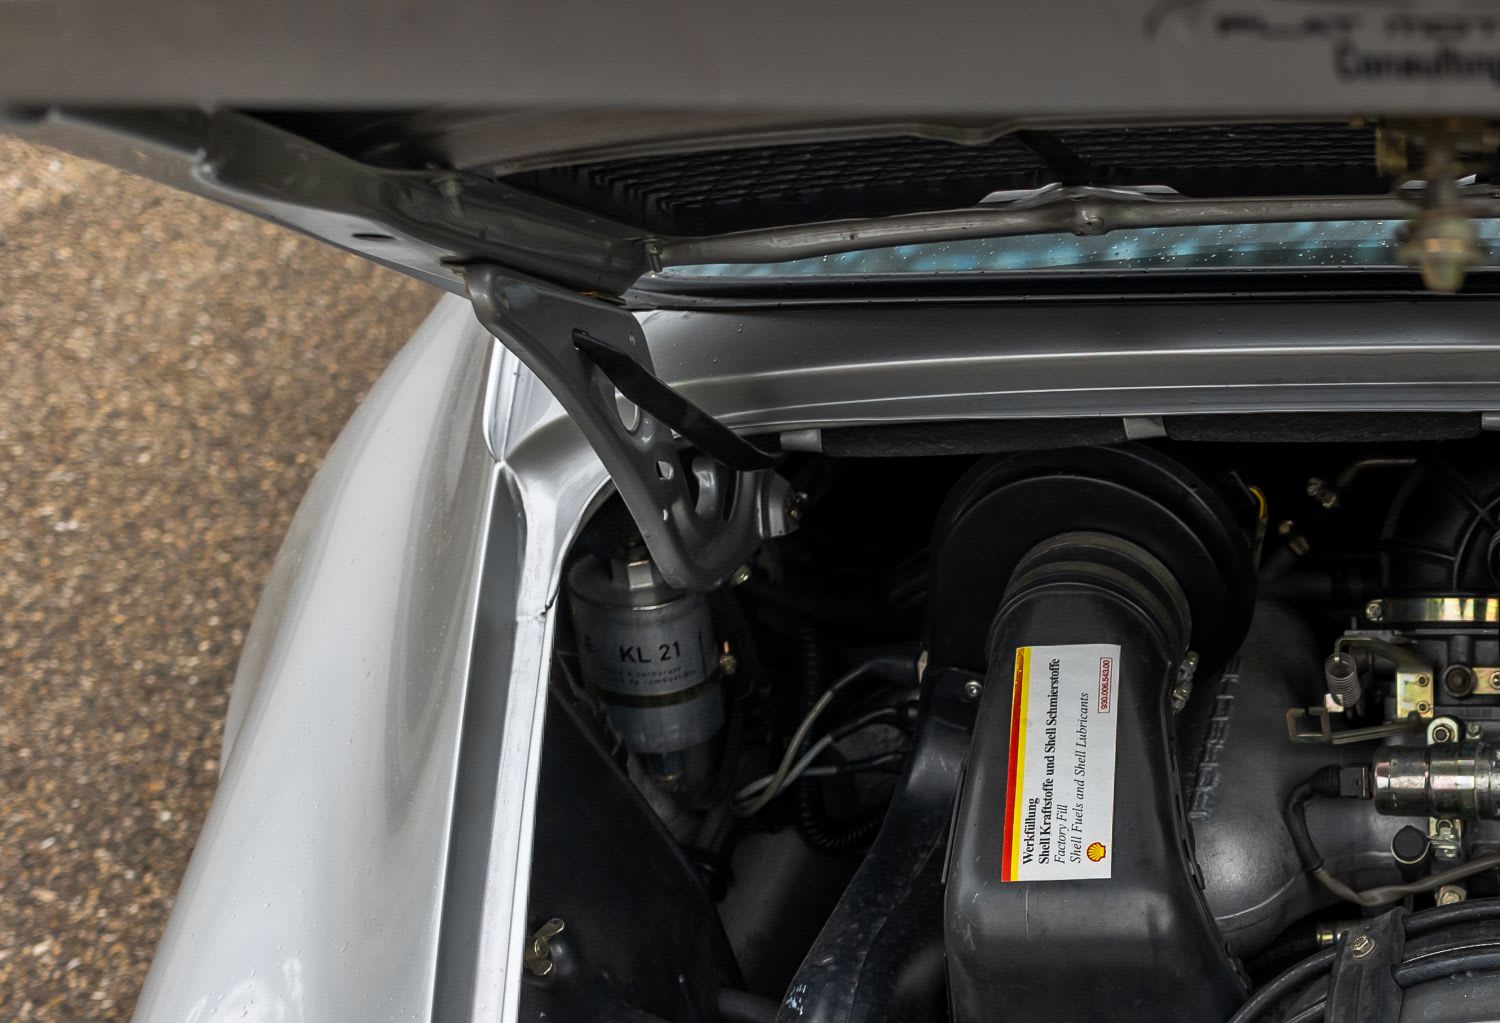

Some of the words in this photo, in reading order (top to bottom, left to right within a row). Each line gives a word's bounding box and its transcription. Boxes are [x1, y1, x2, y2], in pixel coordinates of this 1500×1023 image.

[619, 646, 652, 664] KL
[658, 641, 680, 661] 21
[1046, 658, 1060, 725] Schmierstoffe
[1076, 693, 1088, 747] Lubricants
[1045, 728, 1056, 753] Shell
[1044, 755, 1054, 775] und
[1074, 751, 1086, 776] Shell
[1074, 780, 1084, 800] and
[1040, 778, 1053, 836] Kraftstoffe
[1057, 804, 1068, 821] Fill
[1072, 803, 1083, 832] Fuels
[1023, 798, 1040, 864] Werkfüllung
[1054, 824, 1069, 864] Factory
[1038, 838, 1050, 864] Shell
[1070, 837, 1081, 863] Shell
